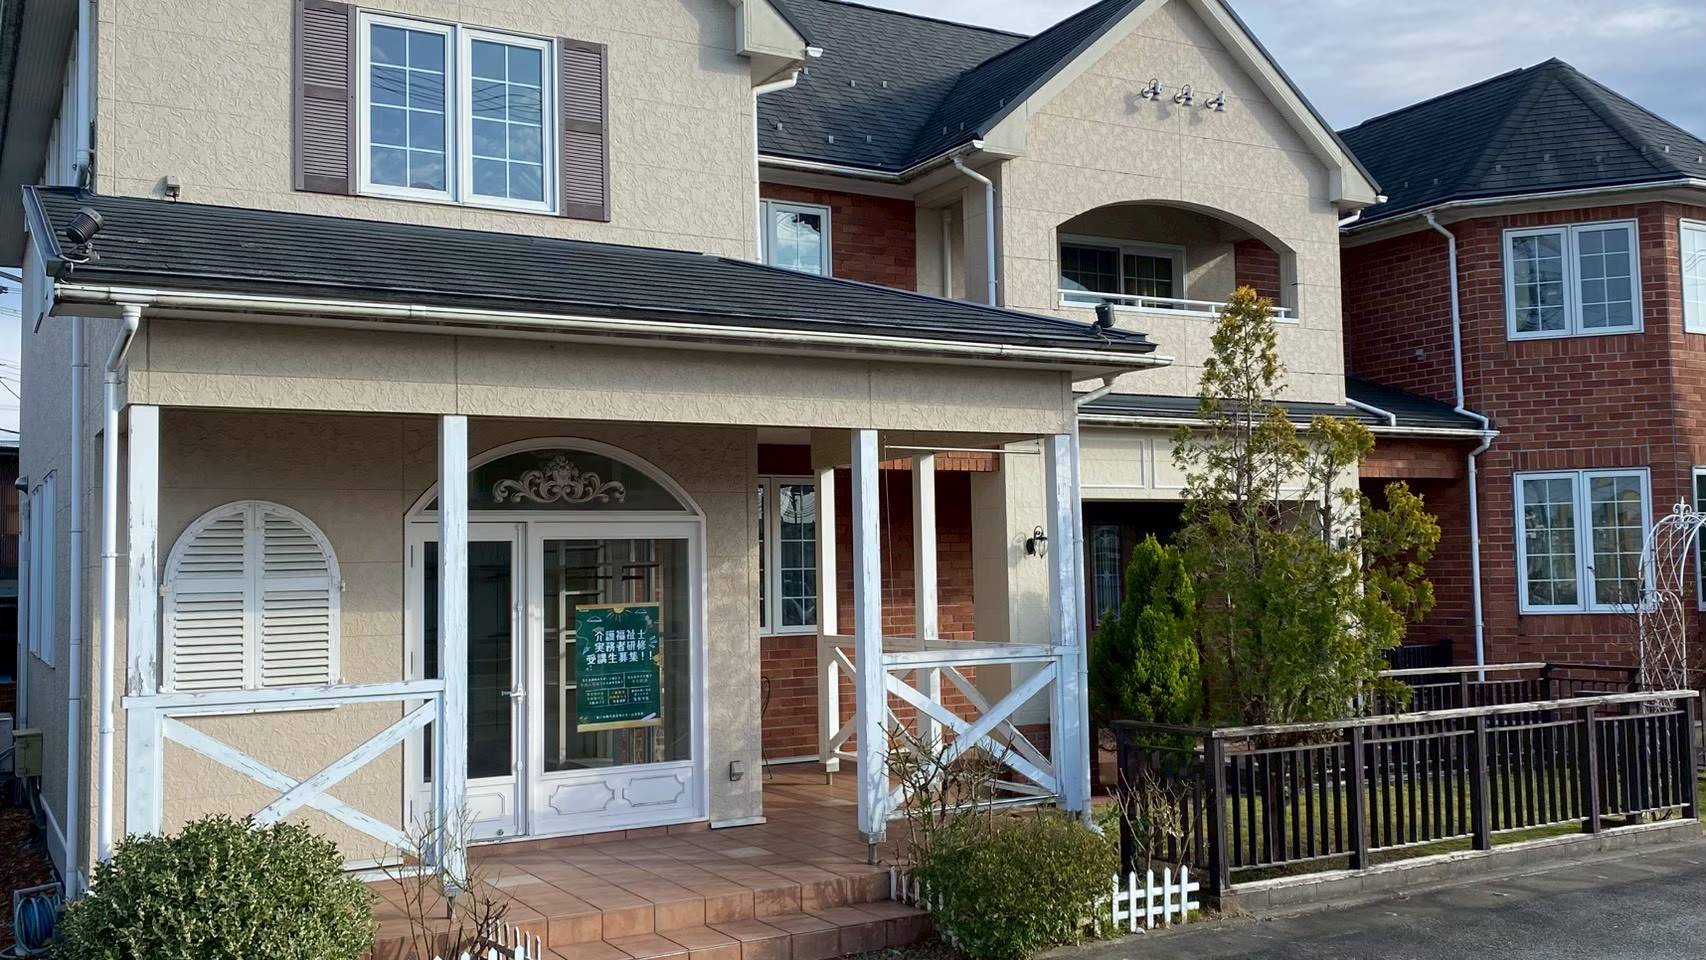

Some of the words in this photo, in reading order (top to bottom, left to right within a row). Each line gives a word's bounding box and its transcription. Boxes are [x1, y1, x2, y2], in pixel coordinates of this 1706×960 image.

[594, 629, 646, 641] 介護福祉士
[594, 640, 646, 653] 実務者研修
